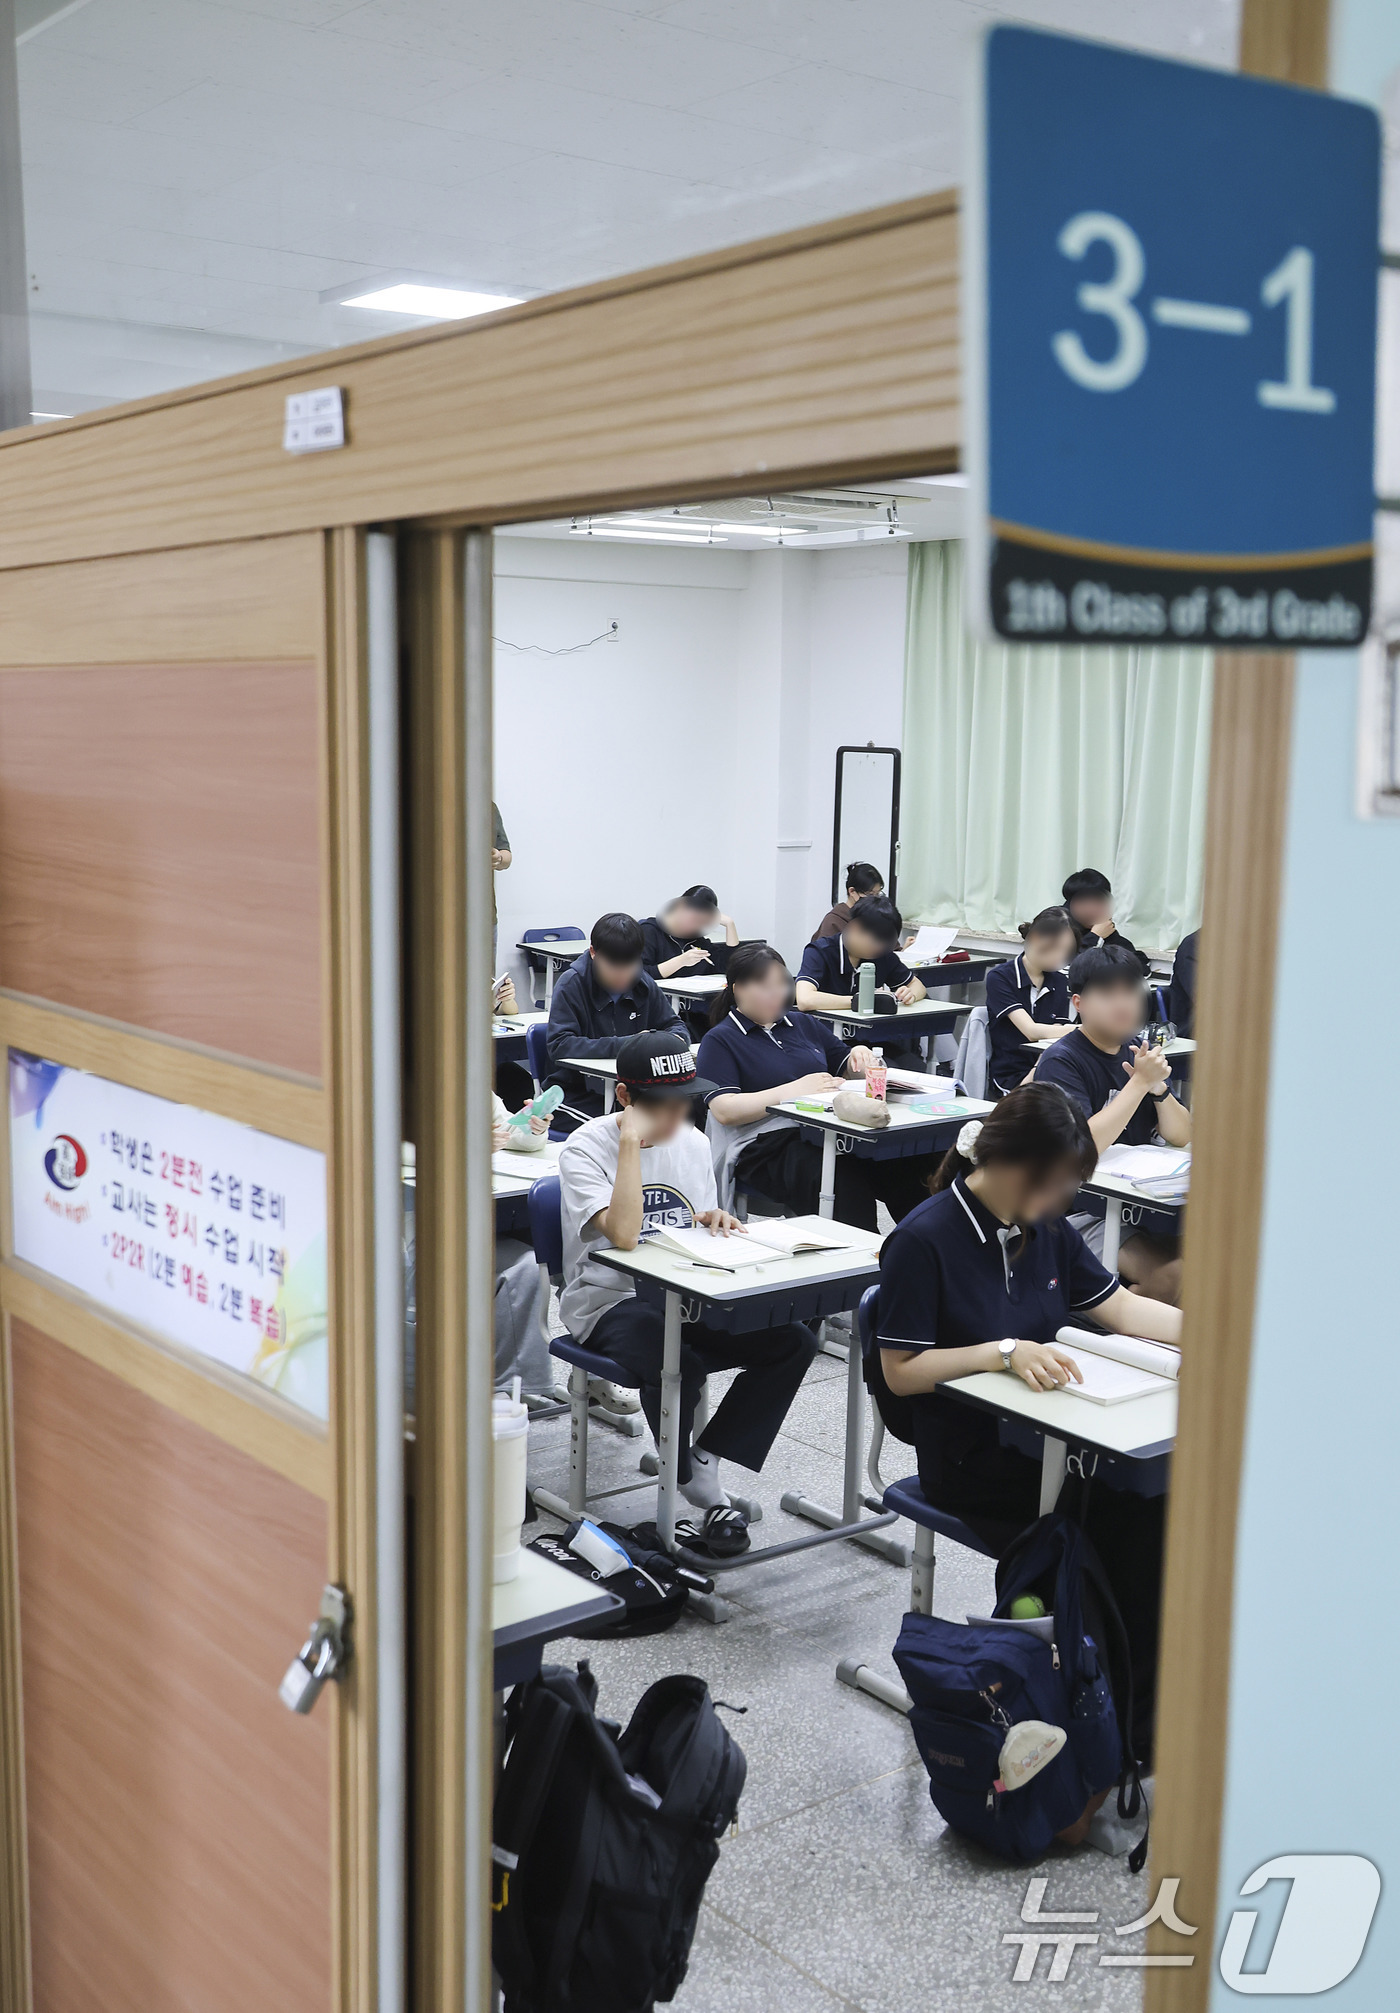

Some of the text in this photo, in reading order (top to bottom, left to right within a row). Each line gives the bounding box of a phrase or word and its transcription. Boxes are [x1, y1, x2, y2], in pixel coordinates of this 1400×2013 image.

[1053, 211, 1336, 414] 3-1
[1005, 578, 1361, 641] 1th Class of 3rd Grade
[650, 1055, 680, 1077] NEW
[111, 1131, 153, 1175] 학생은
[161, 1151, 202, 1195] 2분전
[209, 1170, 242, 1212] 수업
[251, 1184, 285, 1231] 준비
[642, 1190, 670, 1206] TEL
[112, 1180, 285, 1287] 교사는 정시 수업 시작
[220, 1283, 243, 1322] 2분
